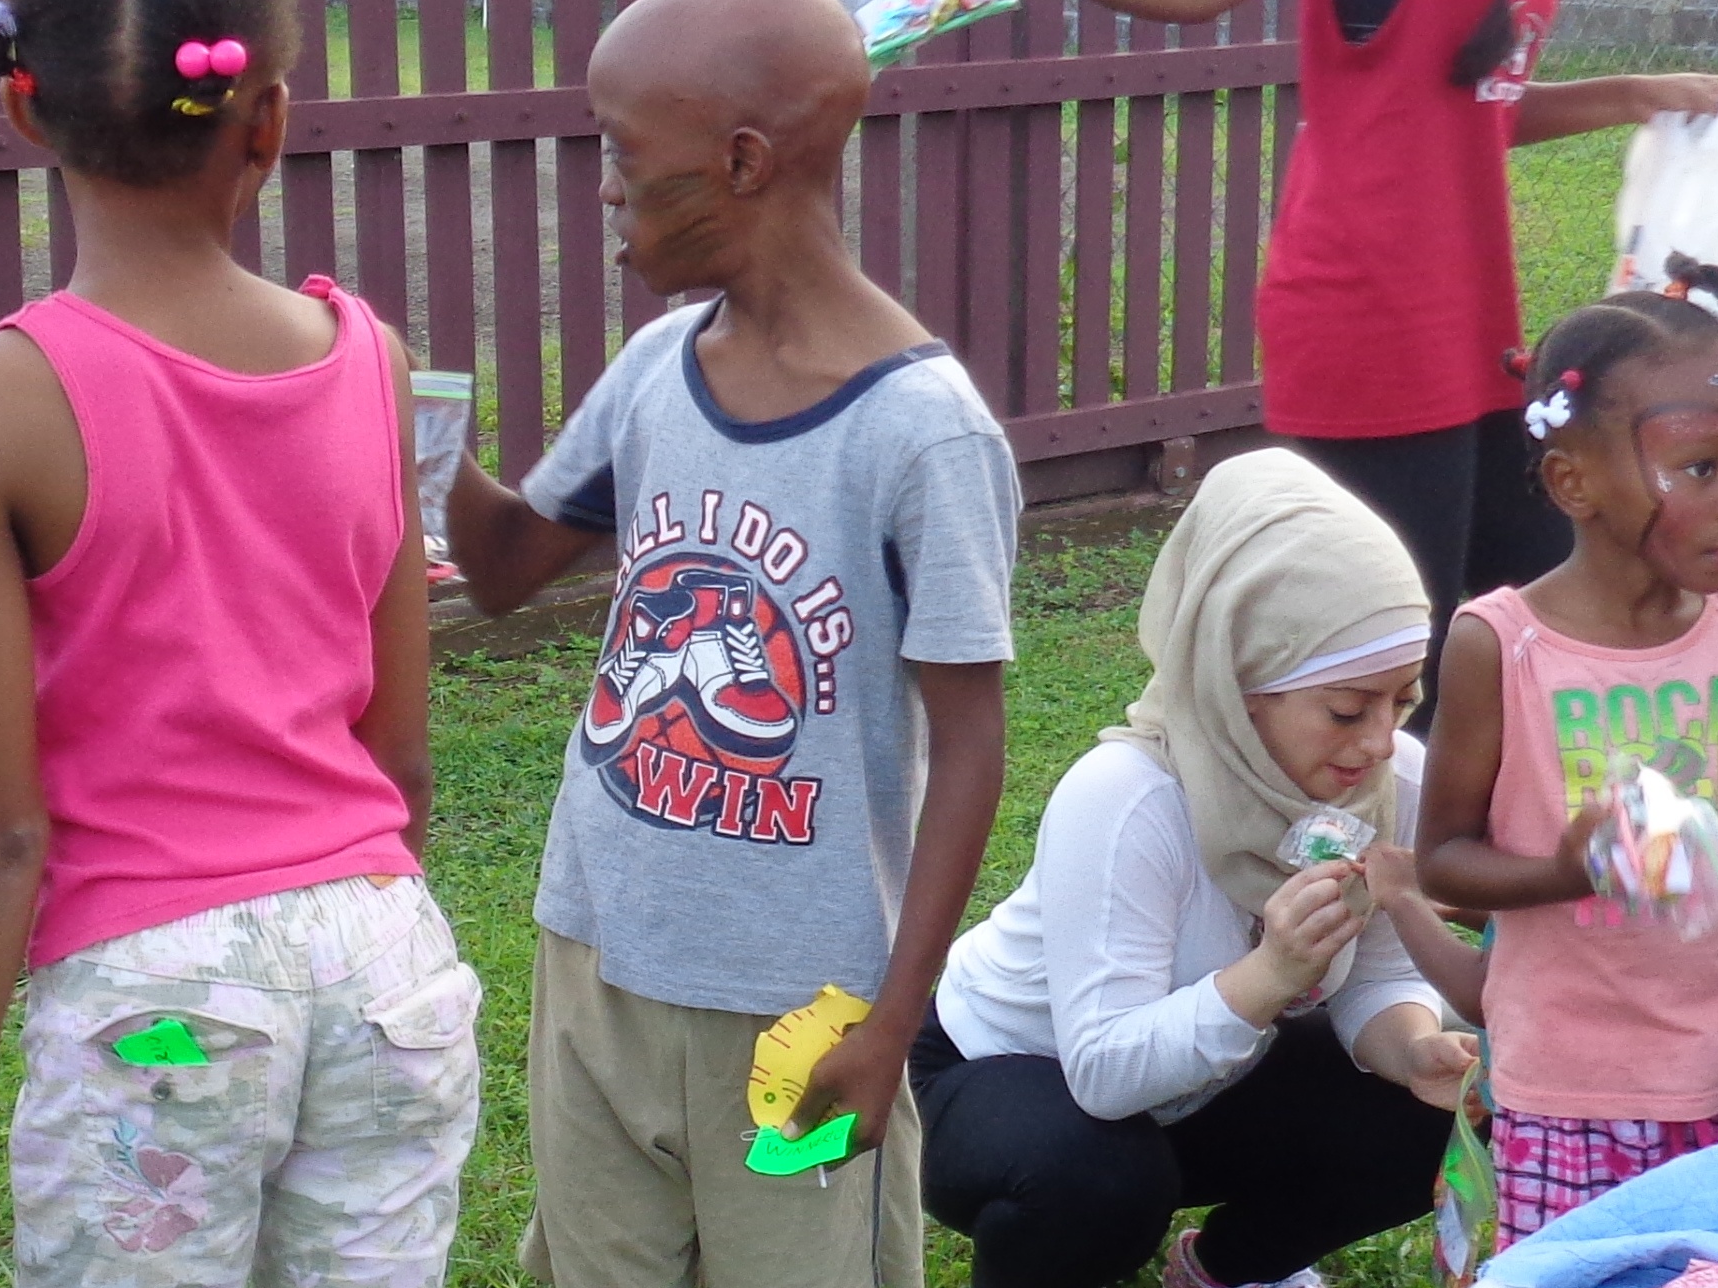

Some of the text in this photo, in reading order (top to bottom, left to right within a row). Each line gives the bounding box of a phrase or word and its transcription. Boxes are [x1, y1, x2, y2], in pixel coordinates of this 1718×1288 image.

[699, 490, 723, 544] I
[732, 500, 808, 585] DO
[635, 740, 822, 844] WIN
